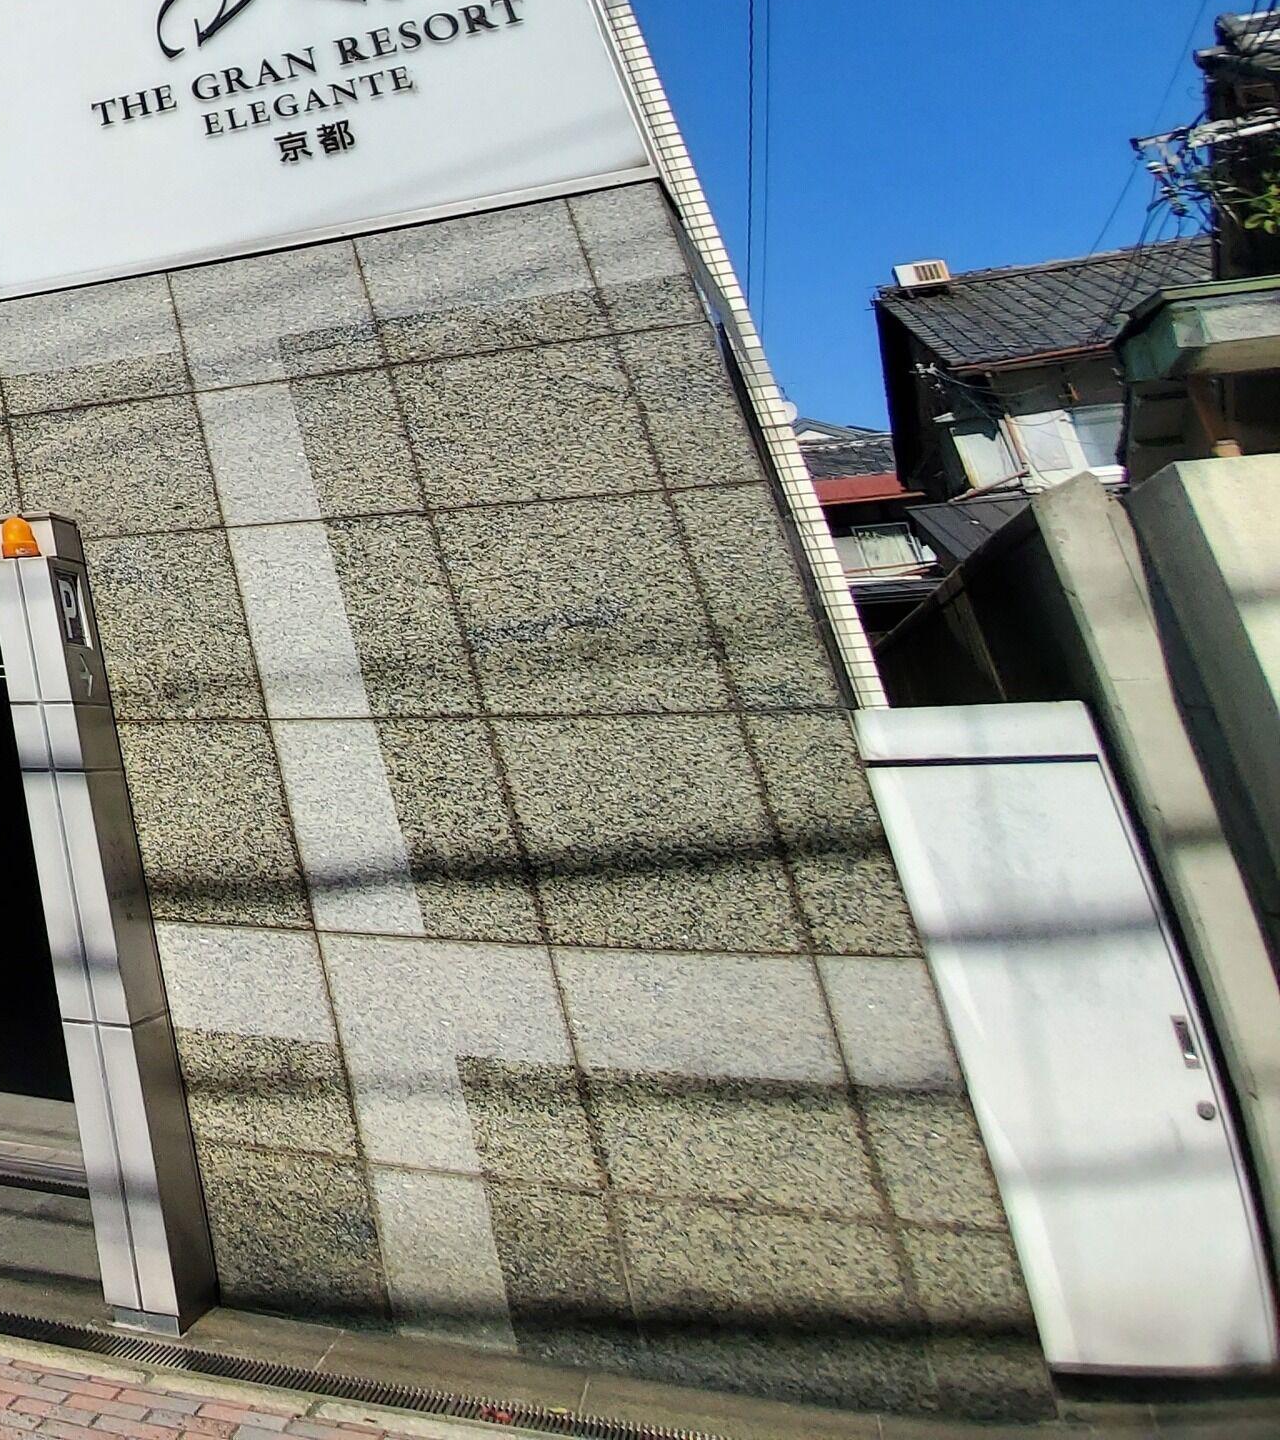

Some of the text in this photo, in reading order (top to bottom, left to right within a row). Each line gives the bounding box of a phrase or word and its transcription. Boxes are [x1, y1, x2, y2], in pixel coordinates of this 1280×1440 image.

[91, 84, 178, 127] THE
[191, 46, 318, 101] GRAN
[201, 65, 414, 136] ELEGANTE
[273, 119, 356, 163] 京都
[57, 578, 78, 640] P
